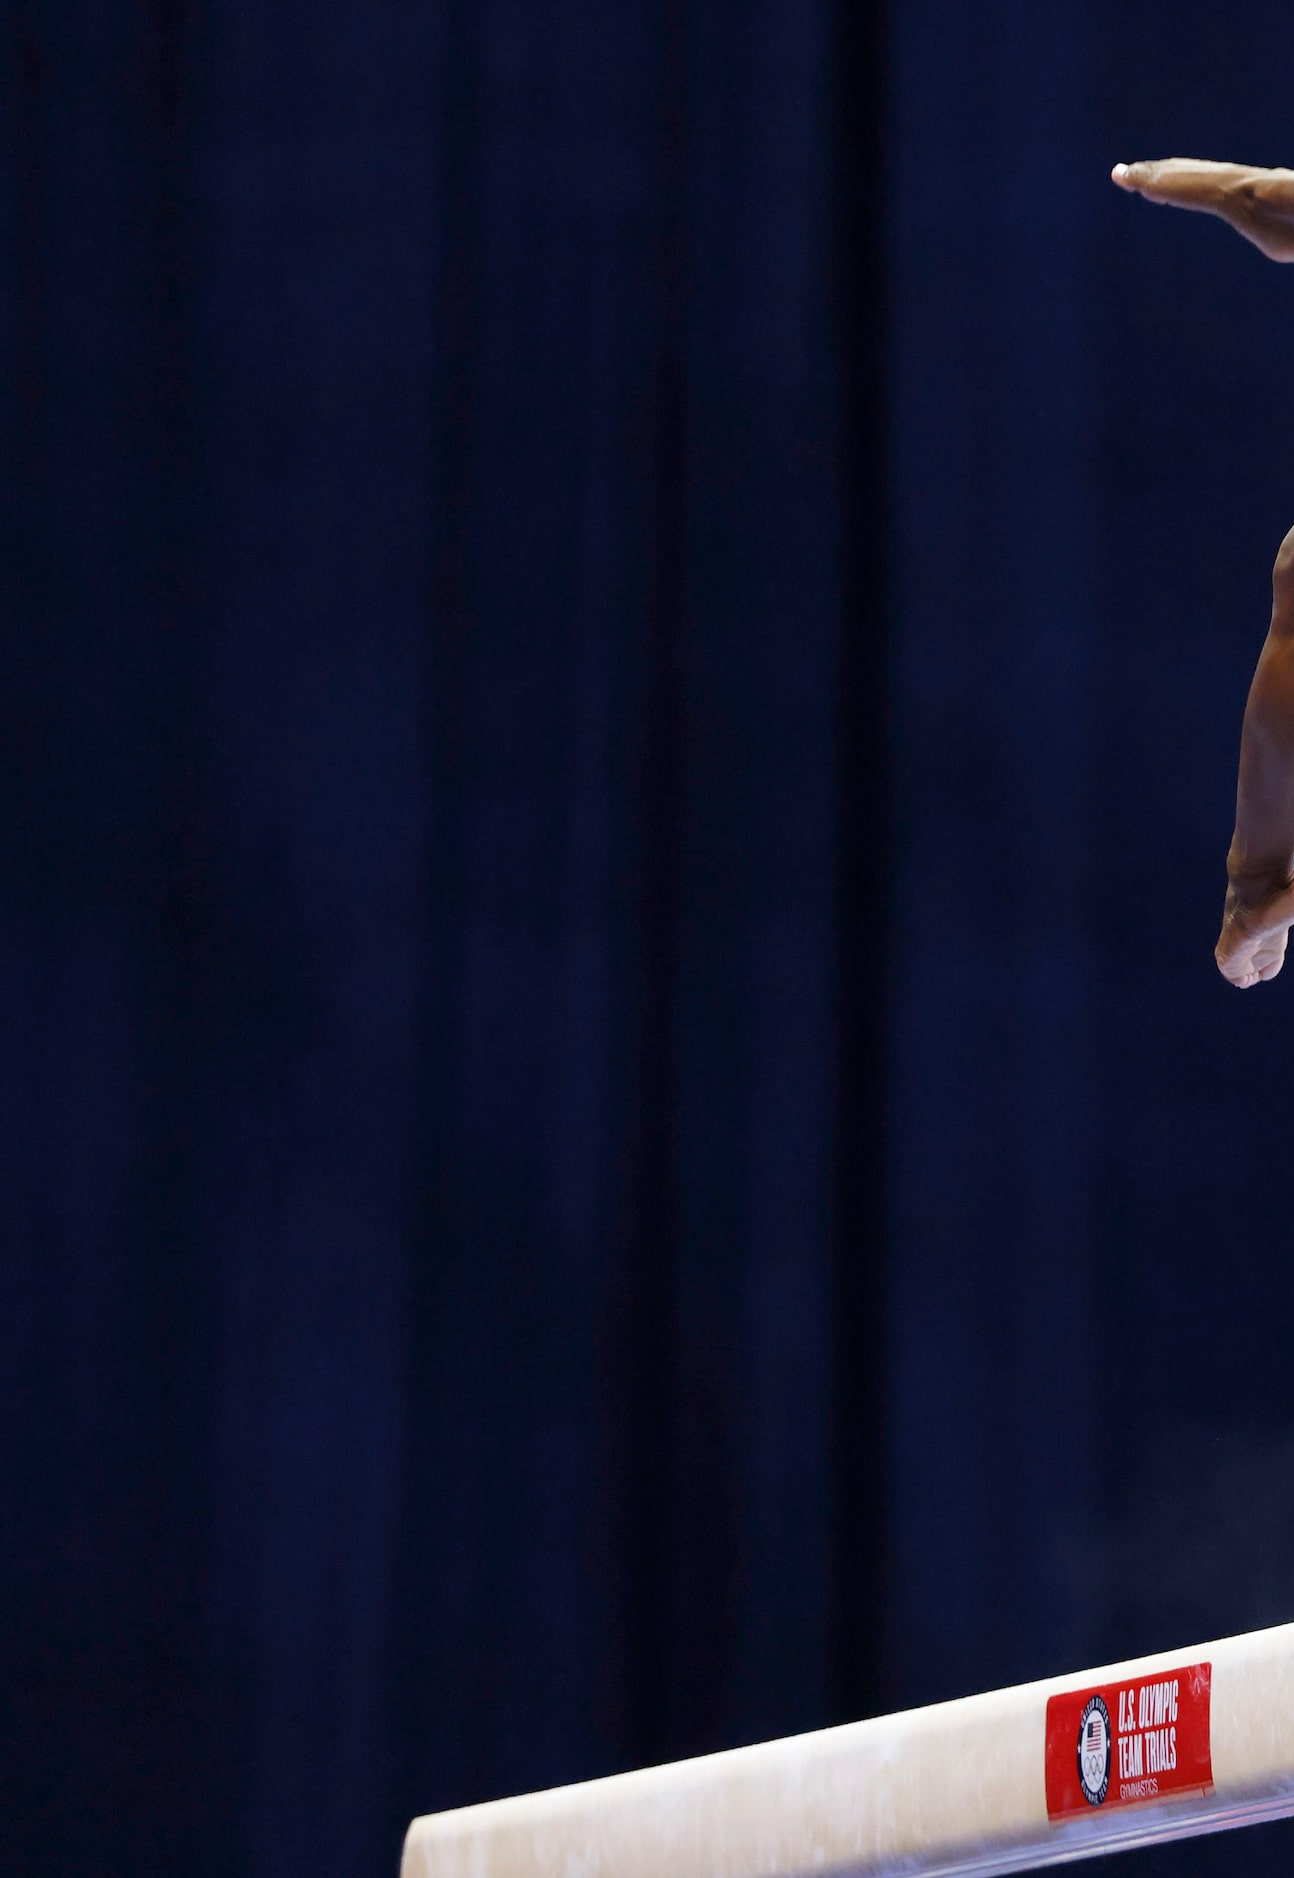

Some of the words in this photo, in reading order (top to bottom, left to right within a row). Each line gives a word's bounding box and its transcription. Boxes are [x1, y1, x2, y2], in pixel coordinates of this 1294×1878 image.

[1118, 1689, 1136, 1733] U.S.
[1138, 1679, 1179, 1729] OLYMPIC
[1118, 1733, 1143, 1780] TEAM
[1144, 1726, 1177, 1774] TRIALS
[1119, 1777, 1158, 1800] GYMNASTICS
